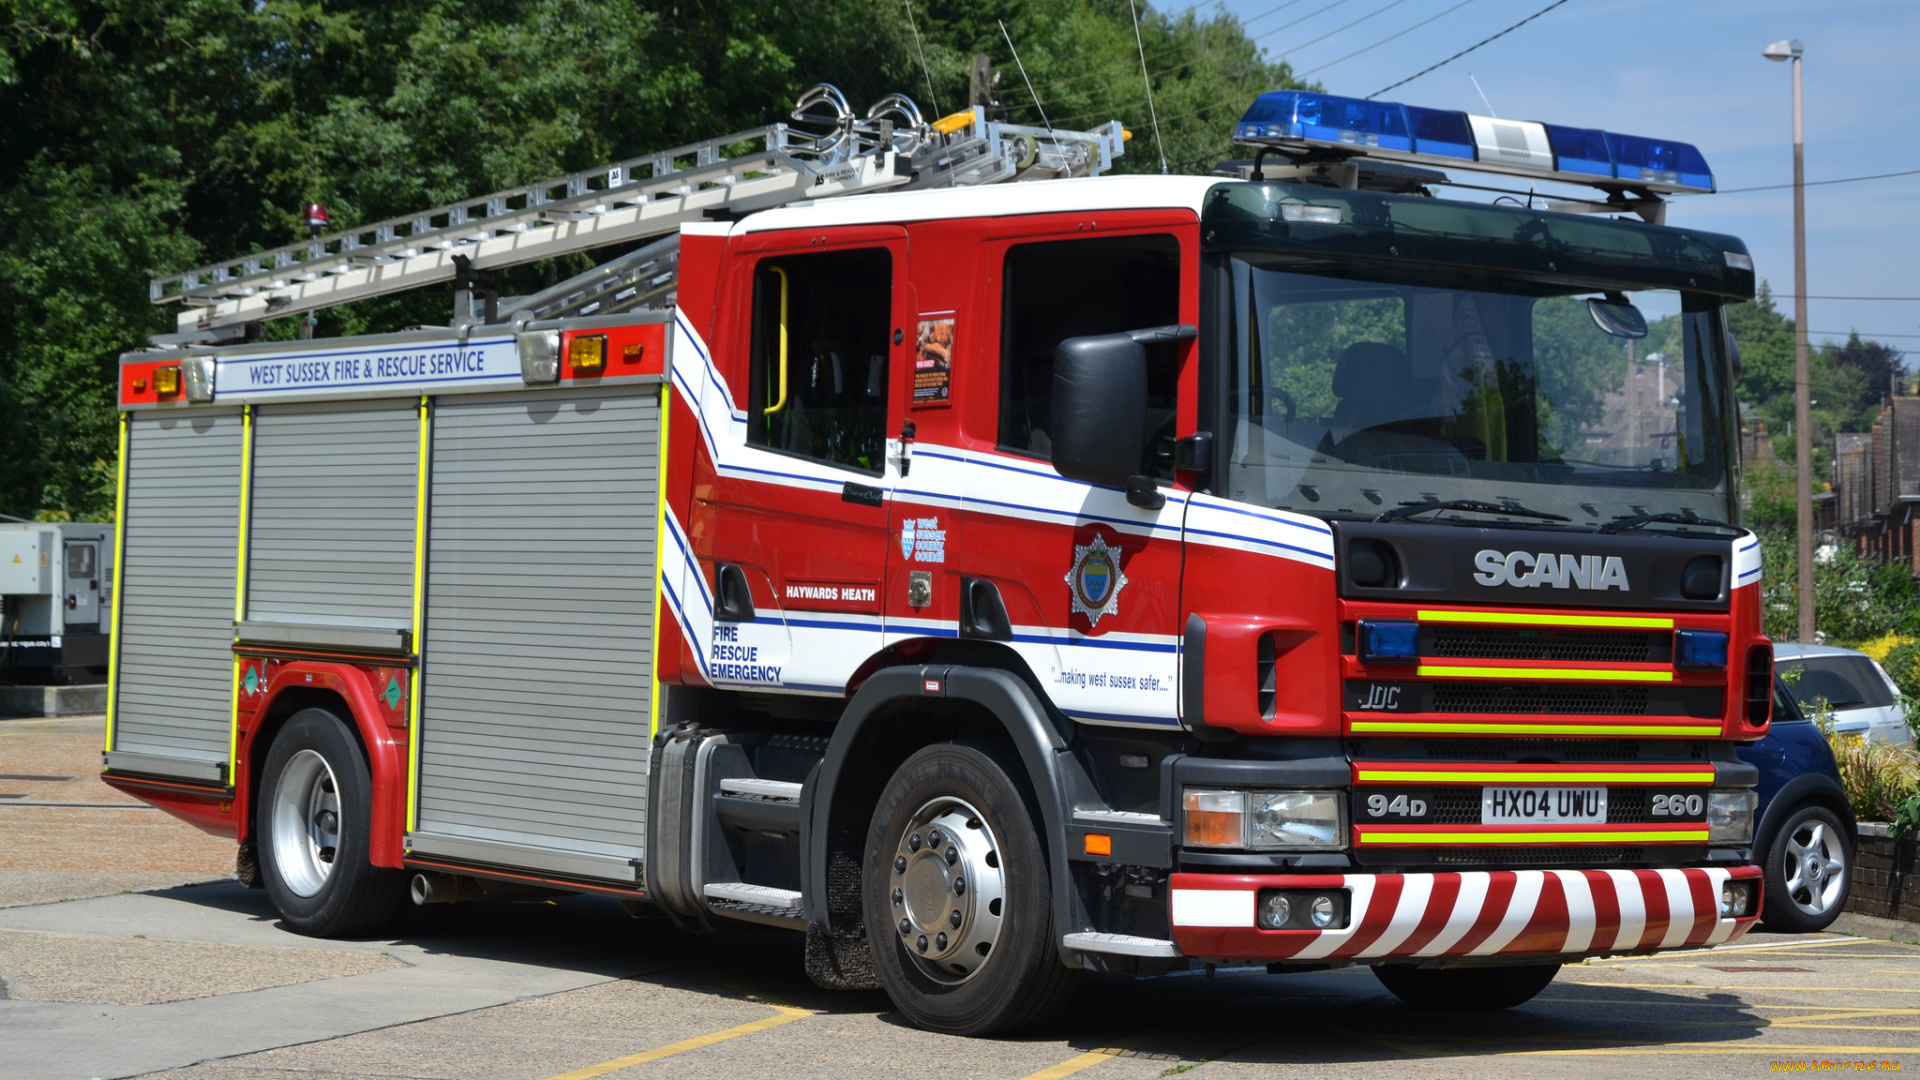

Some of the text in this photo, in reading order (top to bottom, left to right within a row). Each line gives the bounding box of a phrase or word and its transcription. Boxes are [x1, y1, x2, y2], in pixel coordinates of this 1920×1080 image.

[249, 350, 485, 385] WEST SUSSEX FIRE & RESCUE SERVICE
[917, 516, 938, 530] west
[916, 530, 947, 541] sussex
[915, 540, 945, 551] county
[914, 550, 945, 563] council
[1473, 549, 1630, 591] SCANIA
[786, 586, 876, 601] HAYWARDS HEATH
[713, 626, 738, 642] FIRE
[712, 645, 758, 662] RESCUE
[711, 663, 782, 682] EMERGENCY
[1089, 671, 1107, 687] west
[1109, 675, 1137, 690] sussex
[1367, 794, 1428, 817] 94D
[1492, 789, 1599, 818] HX04 UWU
[1651, 794, 1704, 817] 260
